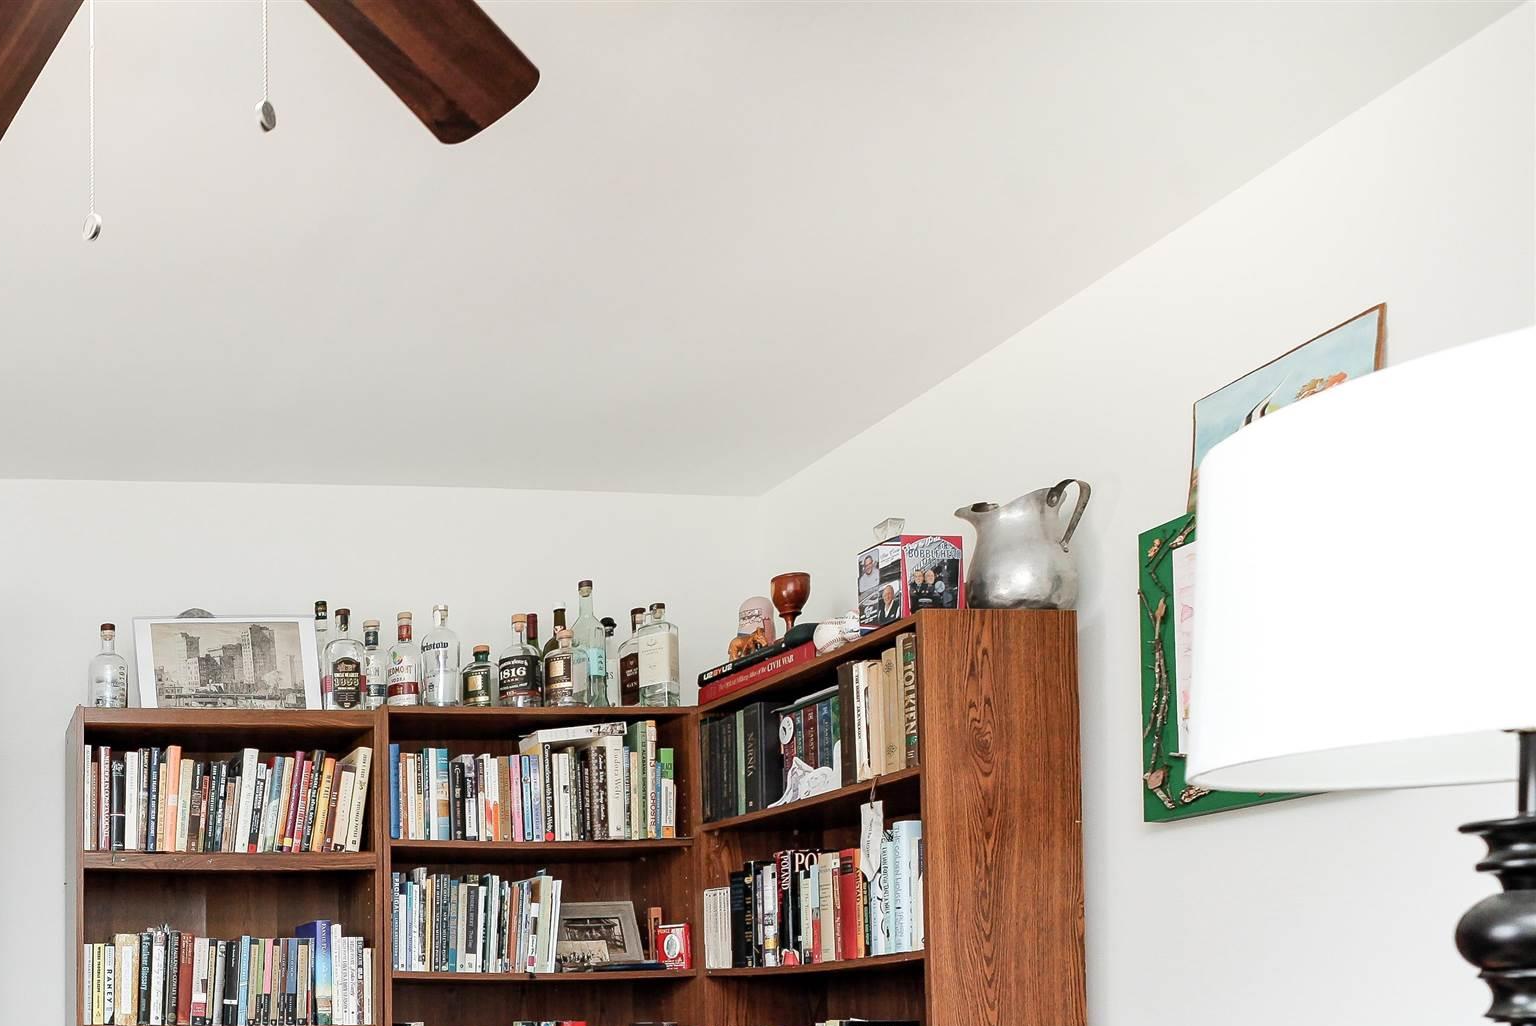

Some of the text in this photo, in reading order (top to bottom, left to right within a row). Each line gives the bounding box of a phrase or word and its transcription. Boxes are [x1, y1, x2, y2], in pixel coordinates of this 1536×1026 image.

[500, 667, 527, 680] 1816
[767, 653, 795, 673] CIVIL WAR
[904, 662, 917, 738] TOLKIEN
[746, 733, 756, 777] NARNIA
[543, 744, 553, 833] Conversations with Eudora Welty
[613, 748, 622, 800] Eudora Welty
[322, 787, 330, 800] TALL
[649, 758, 657, 826] 13 GHOSTS
[352, 824, 360, 838] PAPERS
[780, 855, 790, 890] POLAND
[141, 942, 150, 966] Faulkner
[106, 969, 114, 1003] RANEY
[140, 968, 149, 991] Glossary
